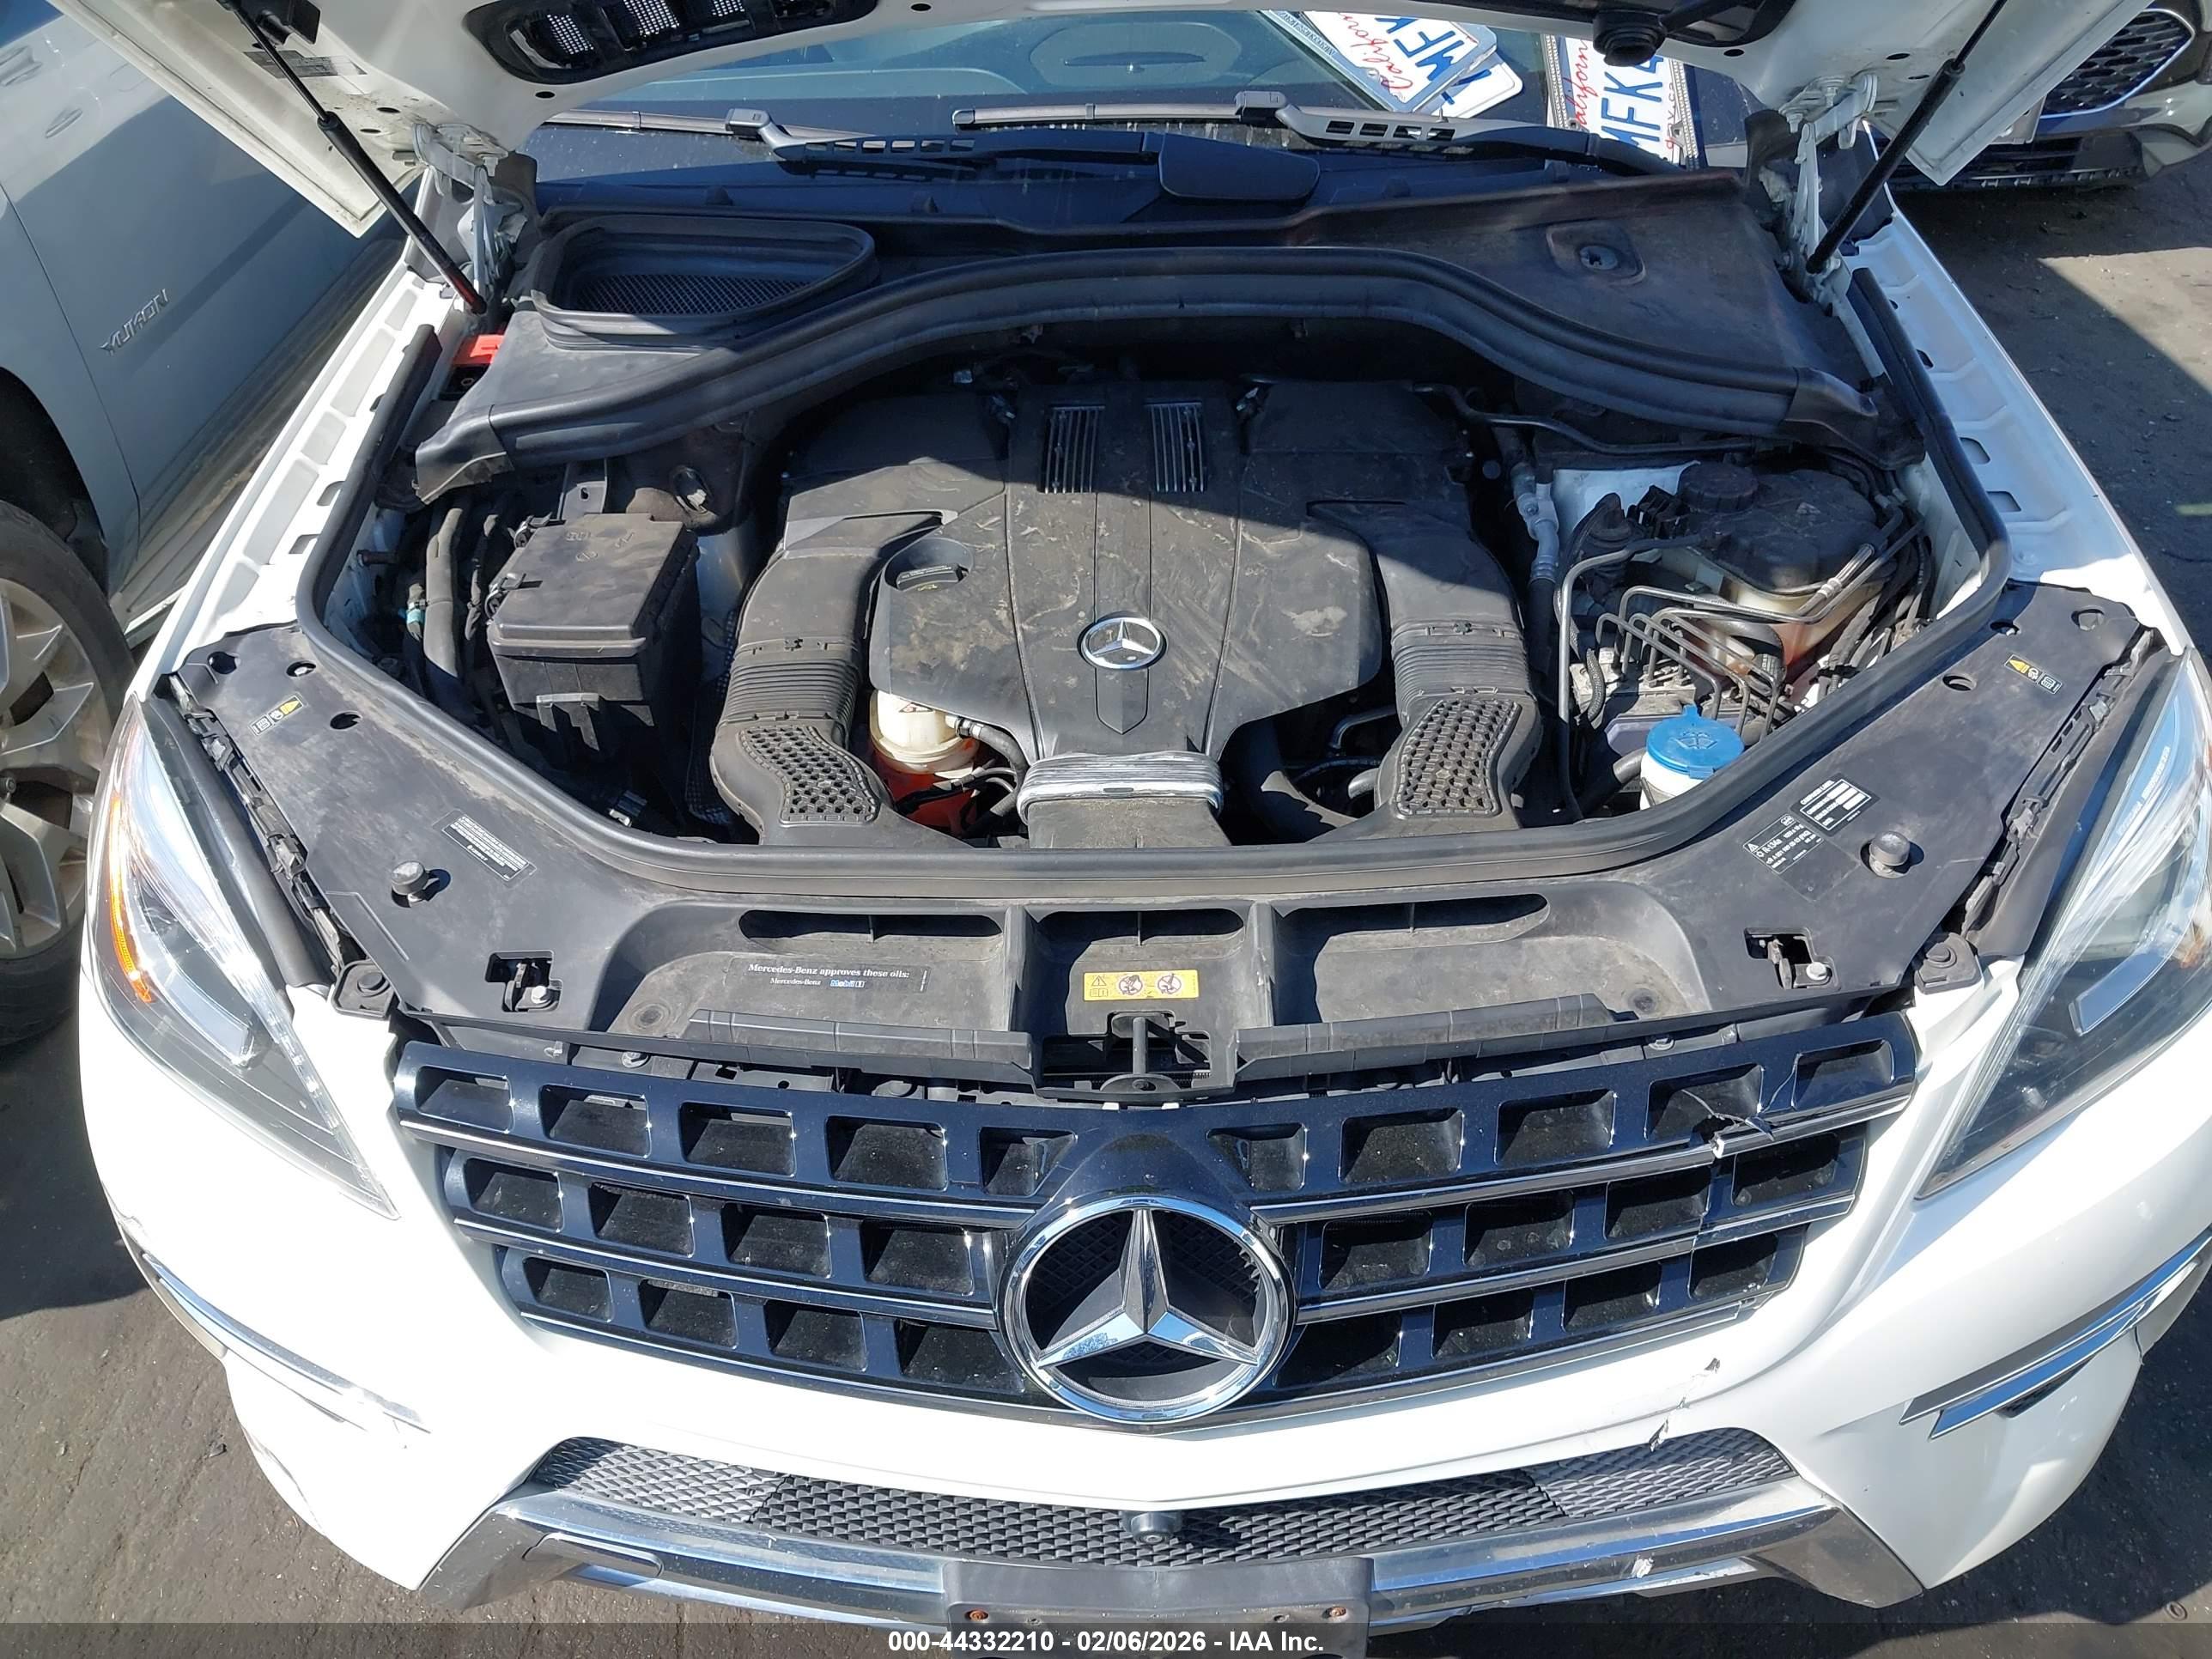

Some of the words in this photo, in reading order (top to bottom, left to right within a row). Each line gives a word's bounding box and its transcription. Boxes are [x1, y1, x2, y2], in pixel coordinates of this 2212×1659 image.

[99, 288, 169, 355] YUKON
[748, 963, 818, 975] Mercedes-Benz
[819, 968, 860, 977] approves
[862, 969, 889, 978] these
[890, 969, 910, 978] oils:
[769, 977, 821, 986] Mercedes-Benz
